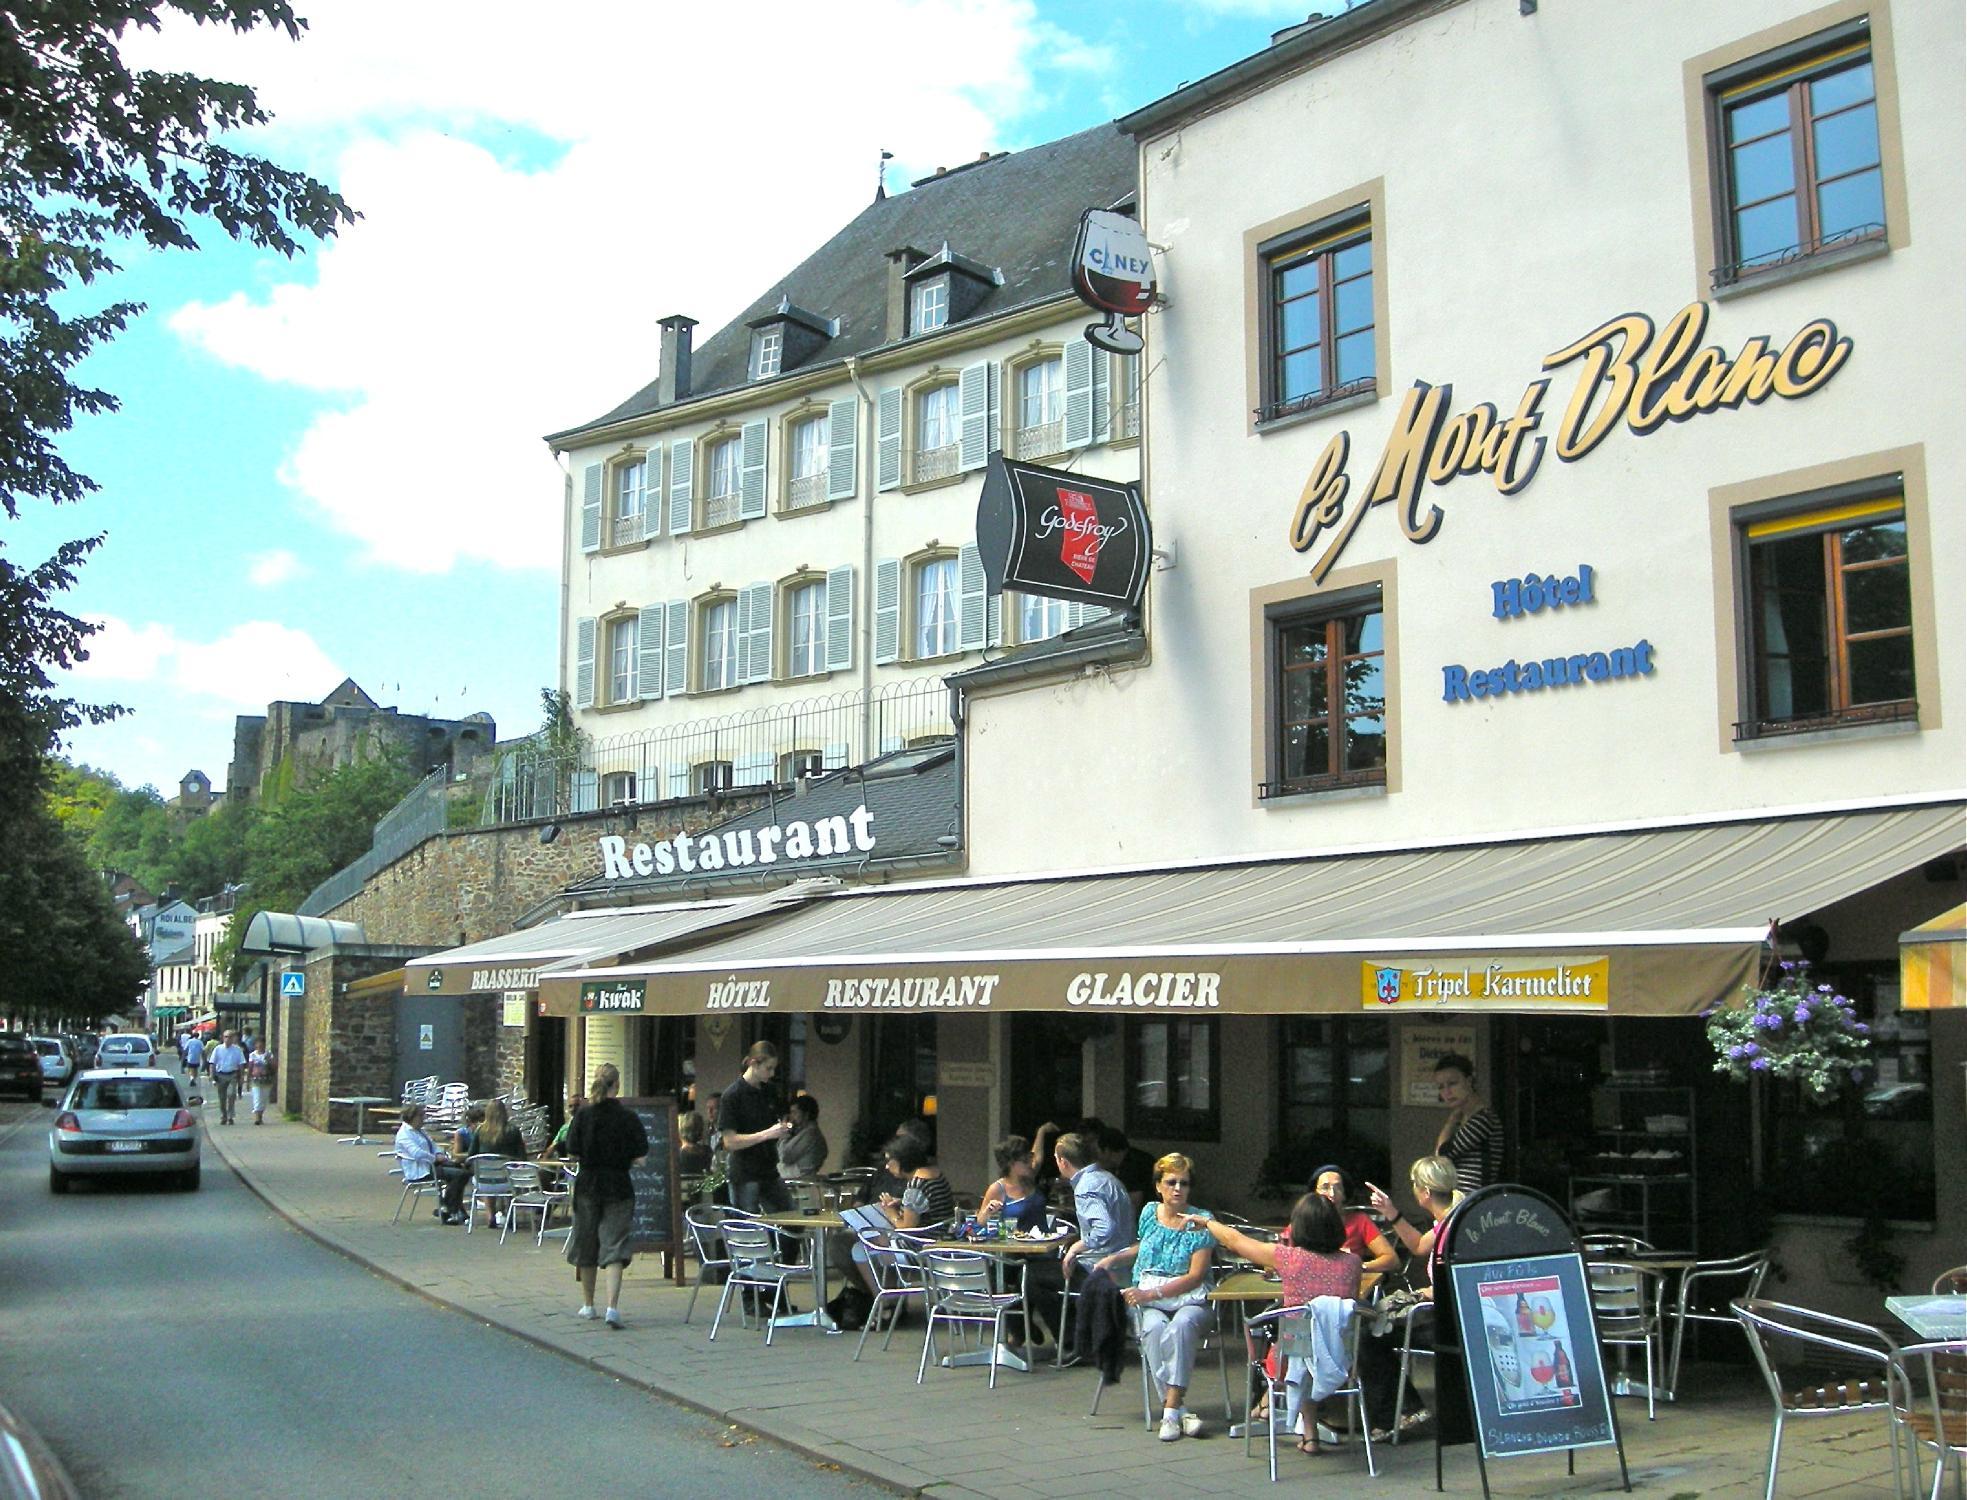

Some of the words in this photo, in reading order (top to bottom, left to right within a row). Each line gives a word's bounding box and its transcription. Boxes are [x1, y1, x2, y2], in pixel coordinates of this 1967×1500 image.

[1089, 248, 1149, 275] CINEY
[1311, 377, 1555, 585] Mont
[1541, 301, 1854, 463] Blanc
[1035, 505, 1128, 556] Godefroy
[1491, 564, 1595, 620] Hôtel
[1441, 638, 1656, 704] Restaurant
[599, 804, 876, 880] Restaurant
[706, 974, 770, 1009] HÔTEL
[824, 975, 999, 1008] RESTAURANT
[1066, 972, 1221, 1007] GLACIER
[1412, 965, 1472, 1004] Tripel
[1481, 958, 1594, 999] Karmeliet
[1480, 1210, 1513, 1233] Mont
[1516, 1208, 1550, 1237] Blanc
